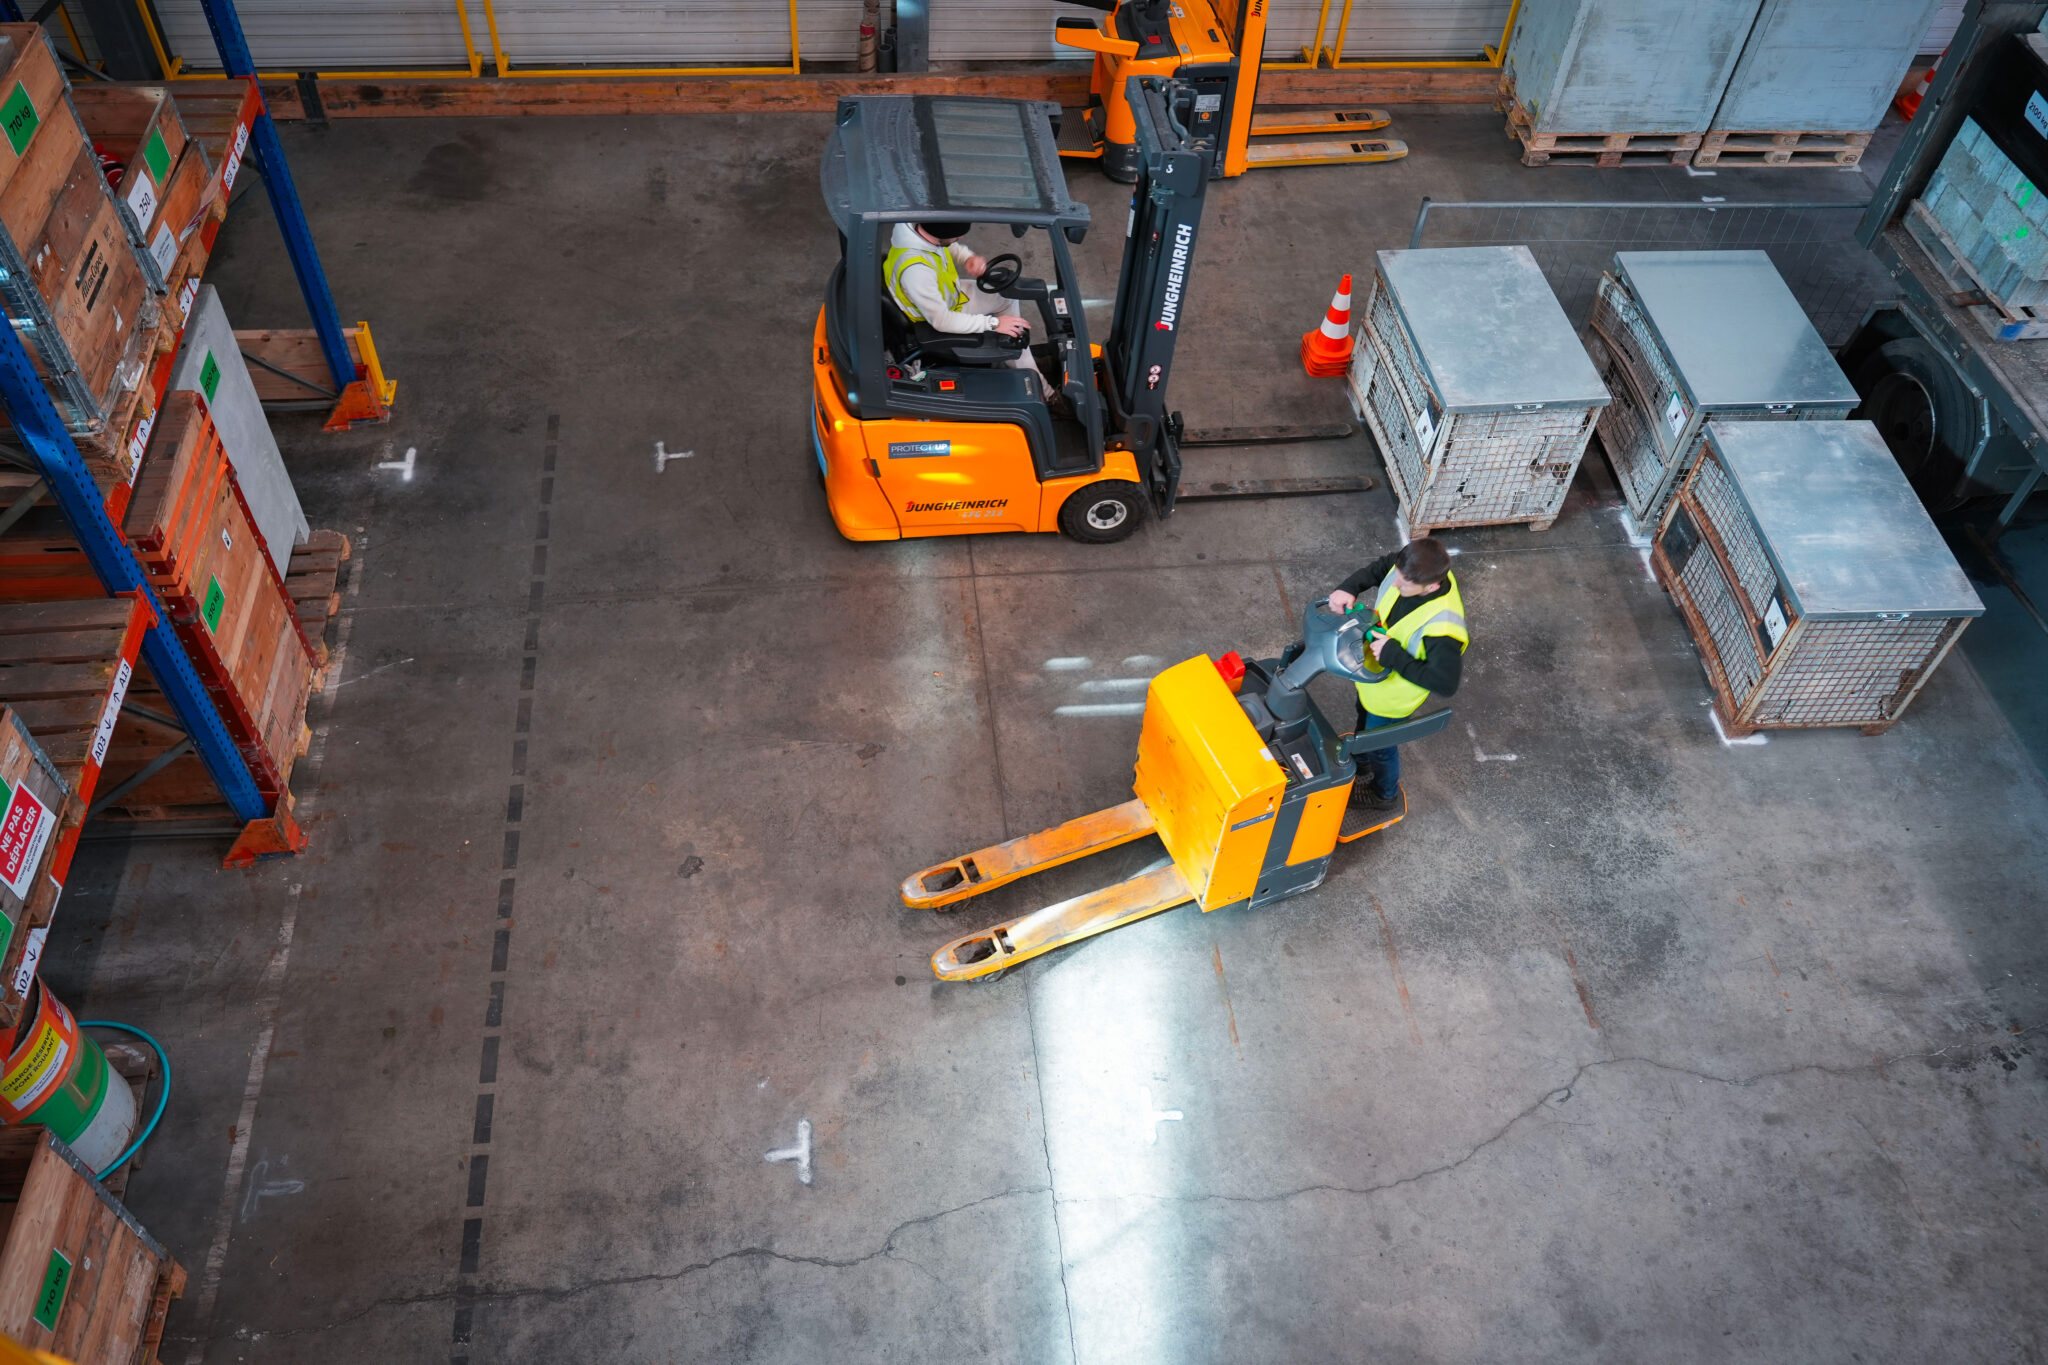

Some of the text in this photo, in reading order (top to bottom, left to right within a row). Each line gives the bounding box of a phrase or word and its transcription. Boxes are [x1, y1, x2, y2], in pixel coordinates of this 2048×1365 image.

[9, 105, 31, 136] 710 kg
[2029, 102, 2042, 119] 2100
[1157, 223, 1193, 331] JUNGHEINRICH
[906, 499, 1009, 513] JUNGHEINRICH
[119, 663, 130, 688] A13
[95, 736, 107, 762] A03
[0, 805, 24, 853] NE PAS
[6, 806, 38, 874] DÉPLACER
[2, 1063, 34, 1092] CHARGE
[13, 1072, 34, 1092] PONT
[33, 1037, 56, 1073] ROULANT
[44, 1267, 63, 1315] 710 kg
